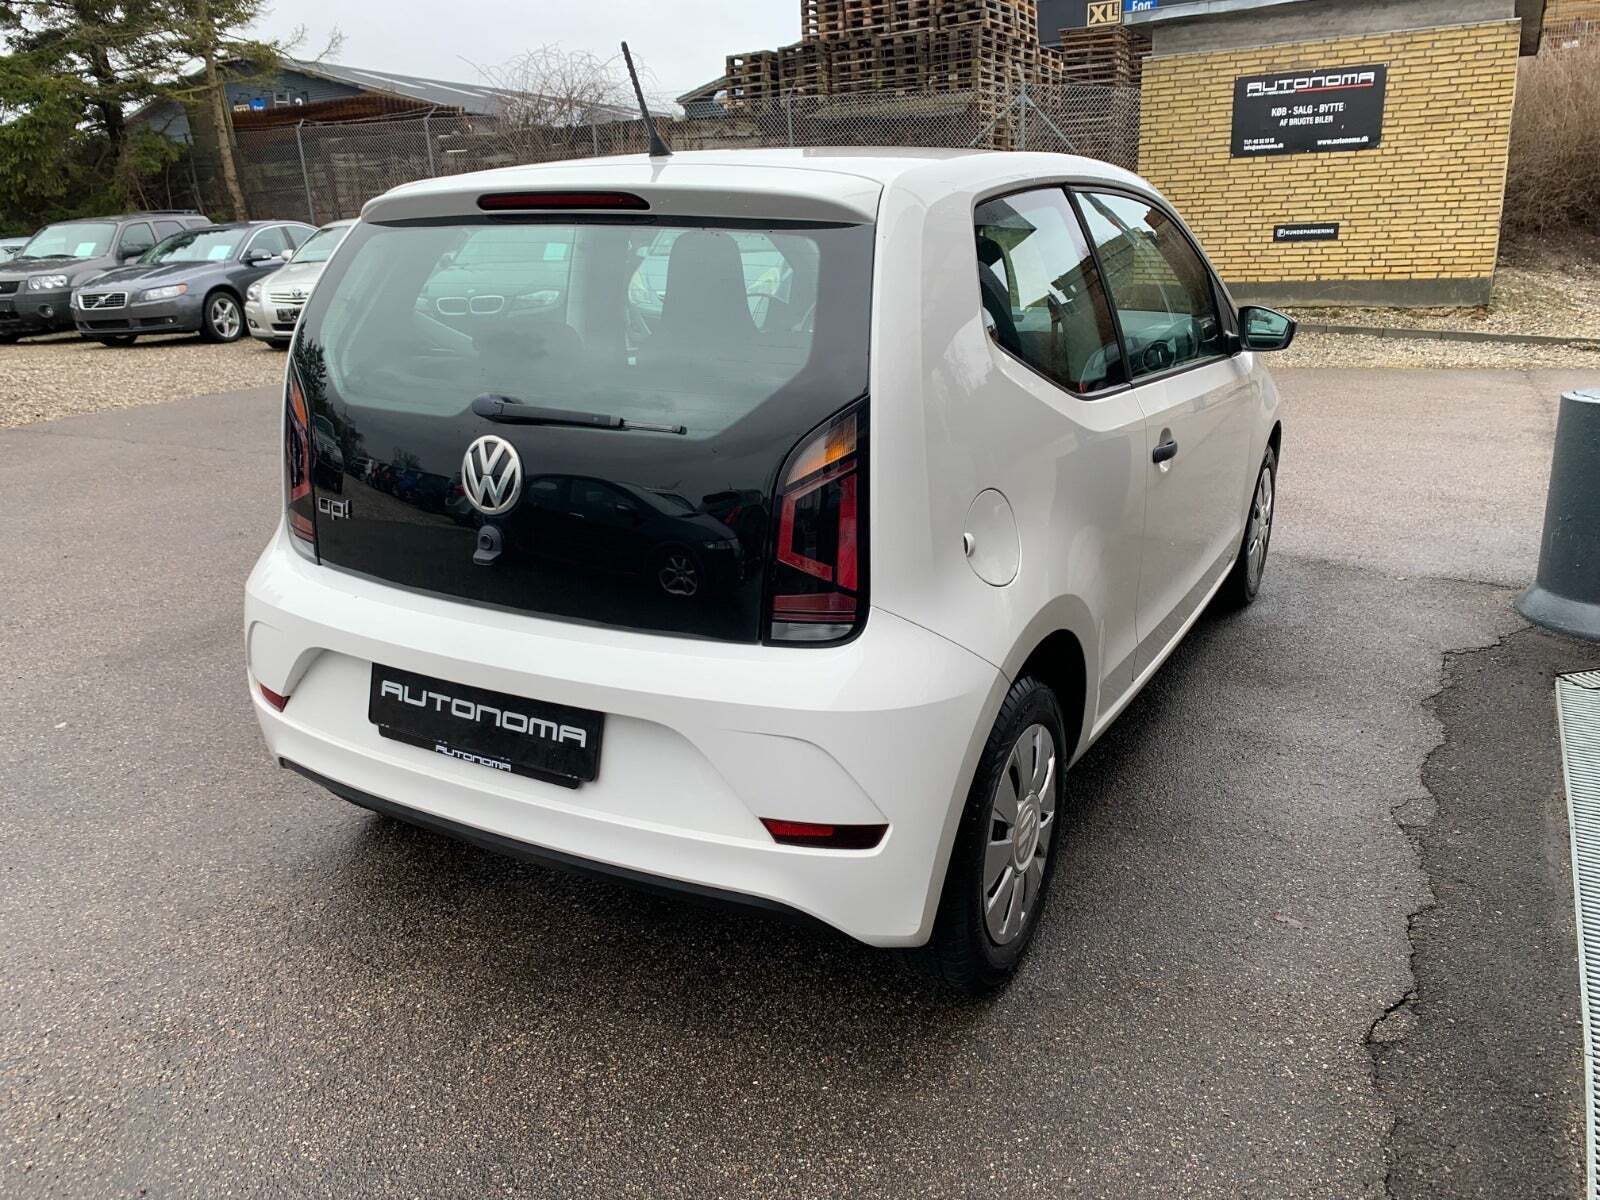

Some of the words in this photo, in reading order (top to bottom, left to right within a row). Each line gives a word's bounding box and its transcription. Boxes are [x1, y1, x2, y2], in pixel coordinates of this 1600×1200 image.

[1089, 3, 1118, 24] XL
[1247, 71, 1375, 92] AUTONOMA
[1271, 107, 1287, 117] KØB
[1293, 105, 1313, 115] SALG
[1319, 102, 1344, 113] BYTTE
[1280, 118, 1288, 126] AF
[1289, 116, 1314, 126] BRUGTE
[1315, 115, 1333, 123] BILER
[381, 680, 587, 748] AUTONOMA
[435, 744, 512, 773] AUTONOMA
